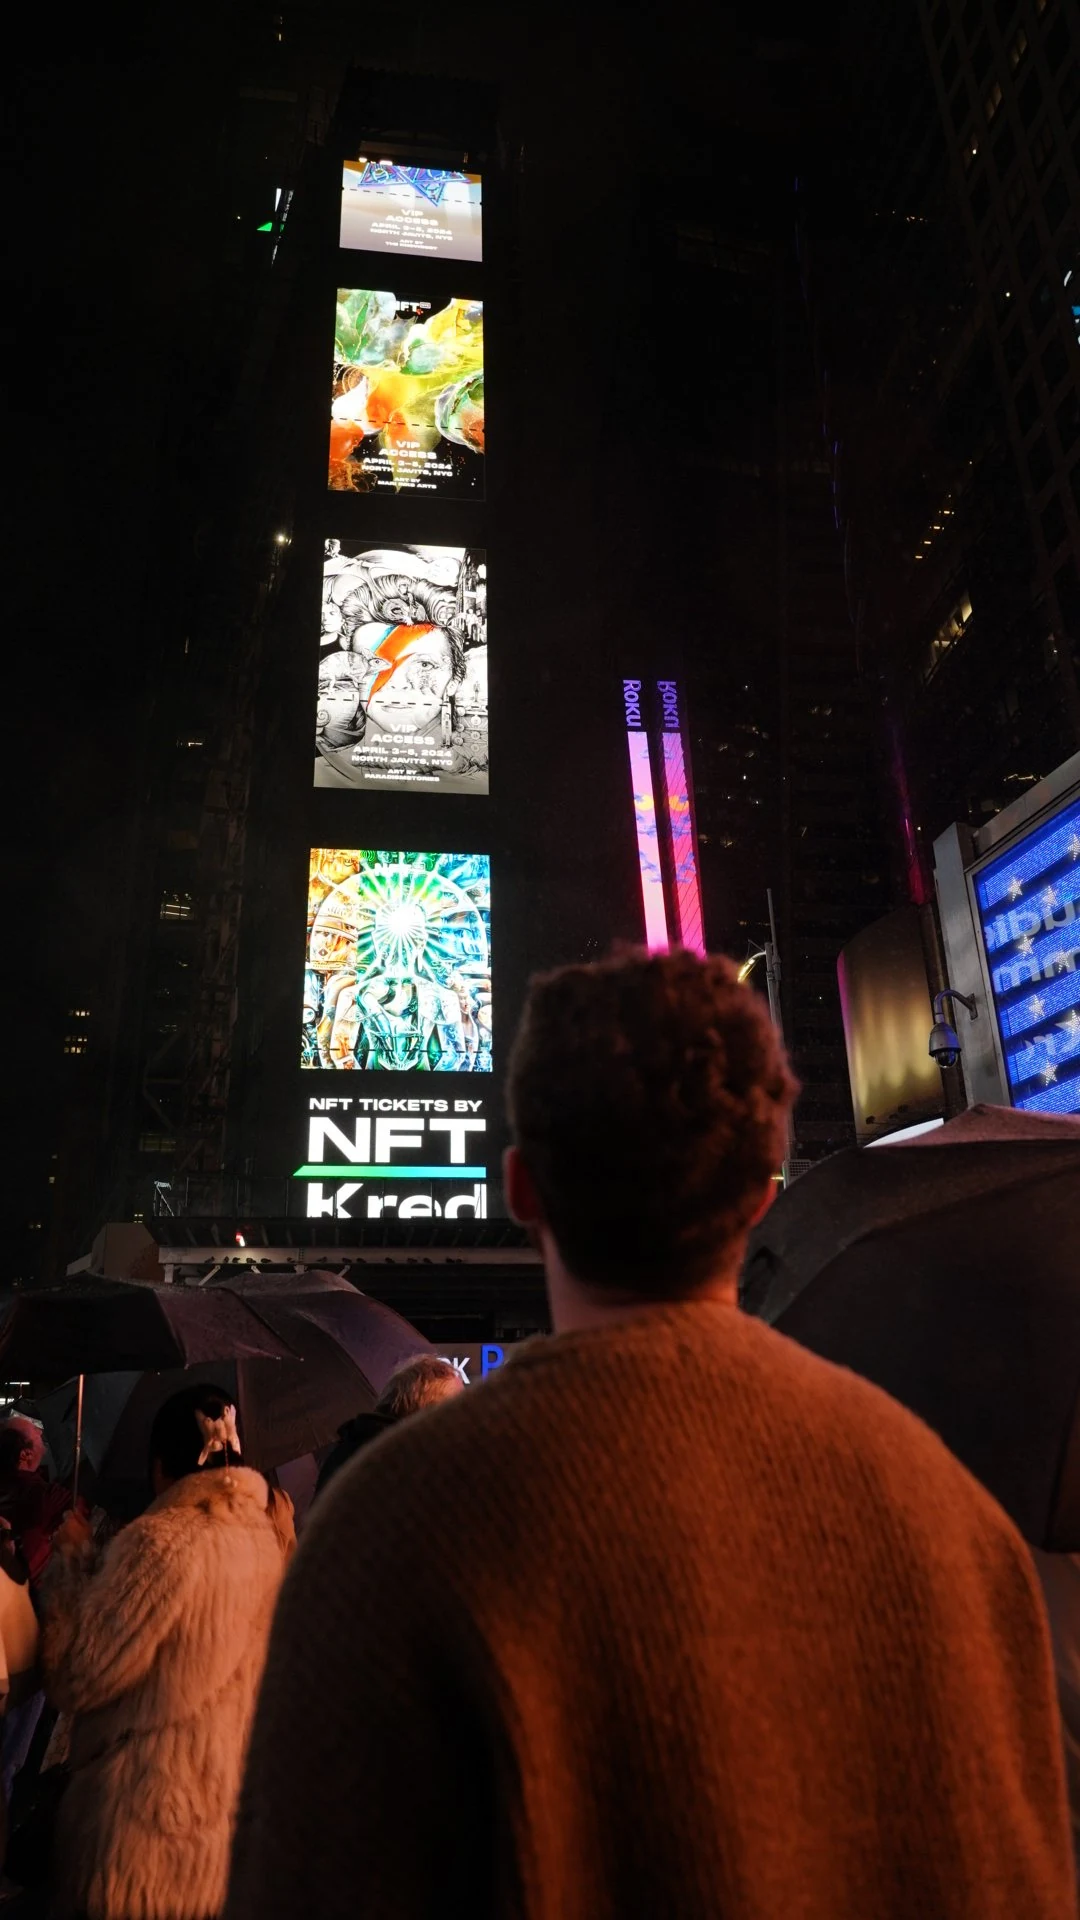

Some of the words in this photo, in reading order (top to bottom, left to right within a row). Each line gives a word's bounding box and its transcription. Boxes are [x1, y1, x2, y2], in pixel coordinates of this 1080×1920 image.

[386, 215, 438, 225] ACCESS
[396, 440, 420, 448] VIP
[379, 448, 437, 460] ACCESS
[363, 457, 394, 465] APRIL
[424, 462, 452, 470] 2024
[362, 464, 394, 472] NORTH
[397, 468, 431, 476] JAVITS,
[390, 724, 418, 733] VIP
[371, 734, 435, 745] ACCESS
[353, 746, 388, 754] APRIL
[351, 755, 388, 763] NORTH
[390, 757, 429, 765] JAVITS,
[309, 1098, 353, 1111] NFT
[359, 1098, 448, 1112] TICKETS
[454, 1100, 482, 1112] BY
[308, 1116, 486, 1164] NFT
[307, 1182, 487, 1219] Kred
